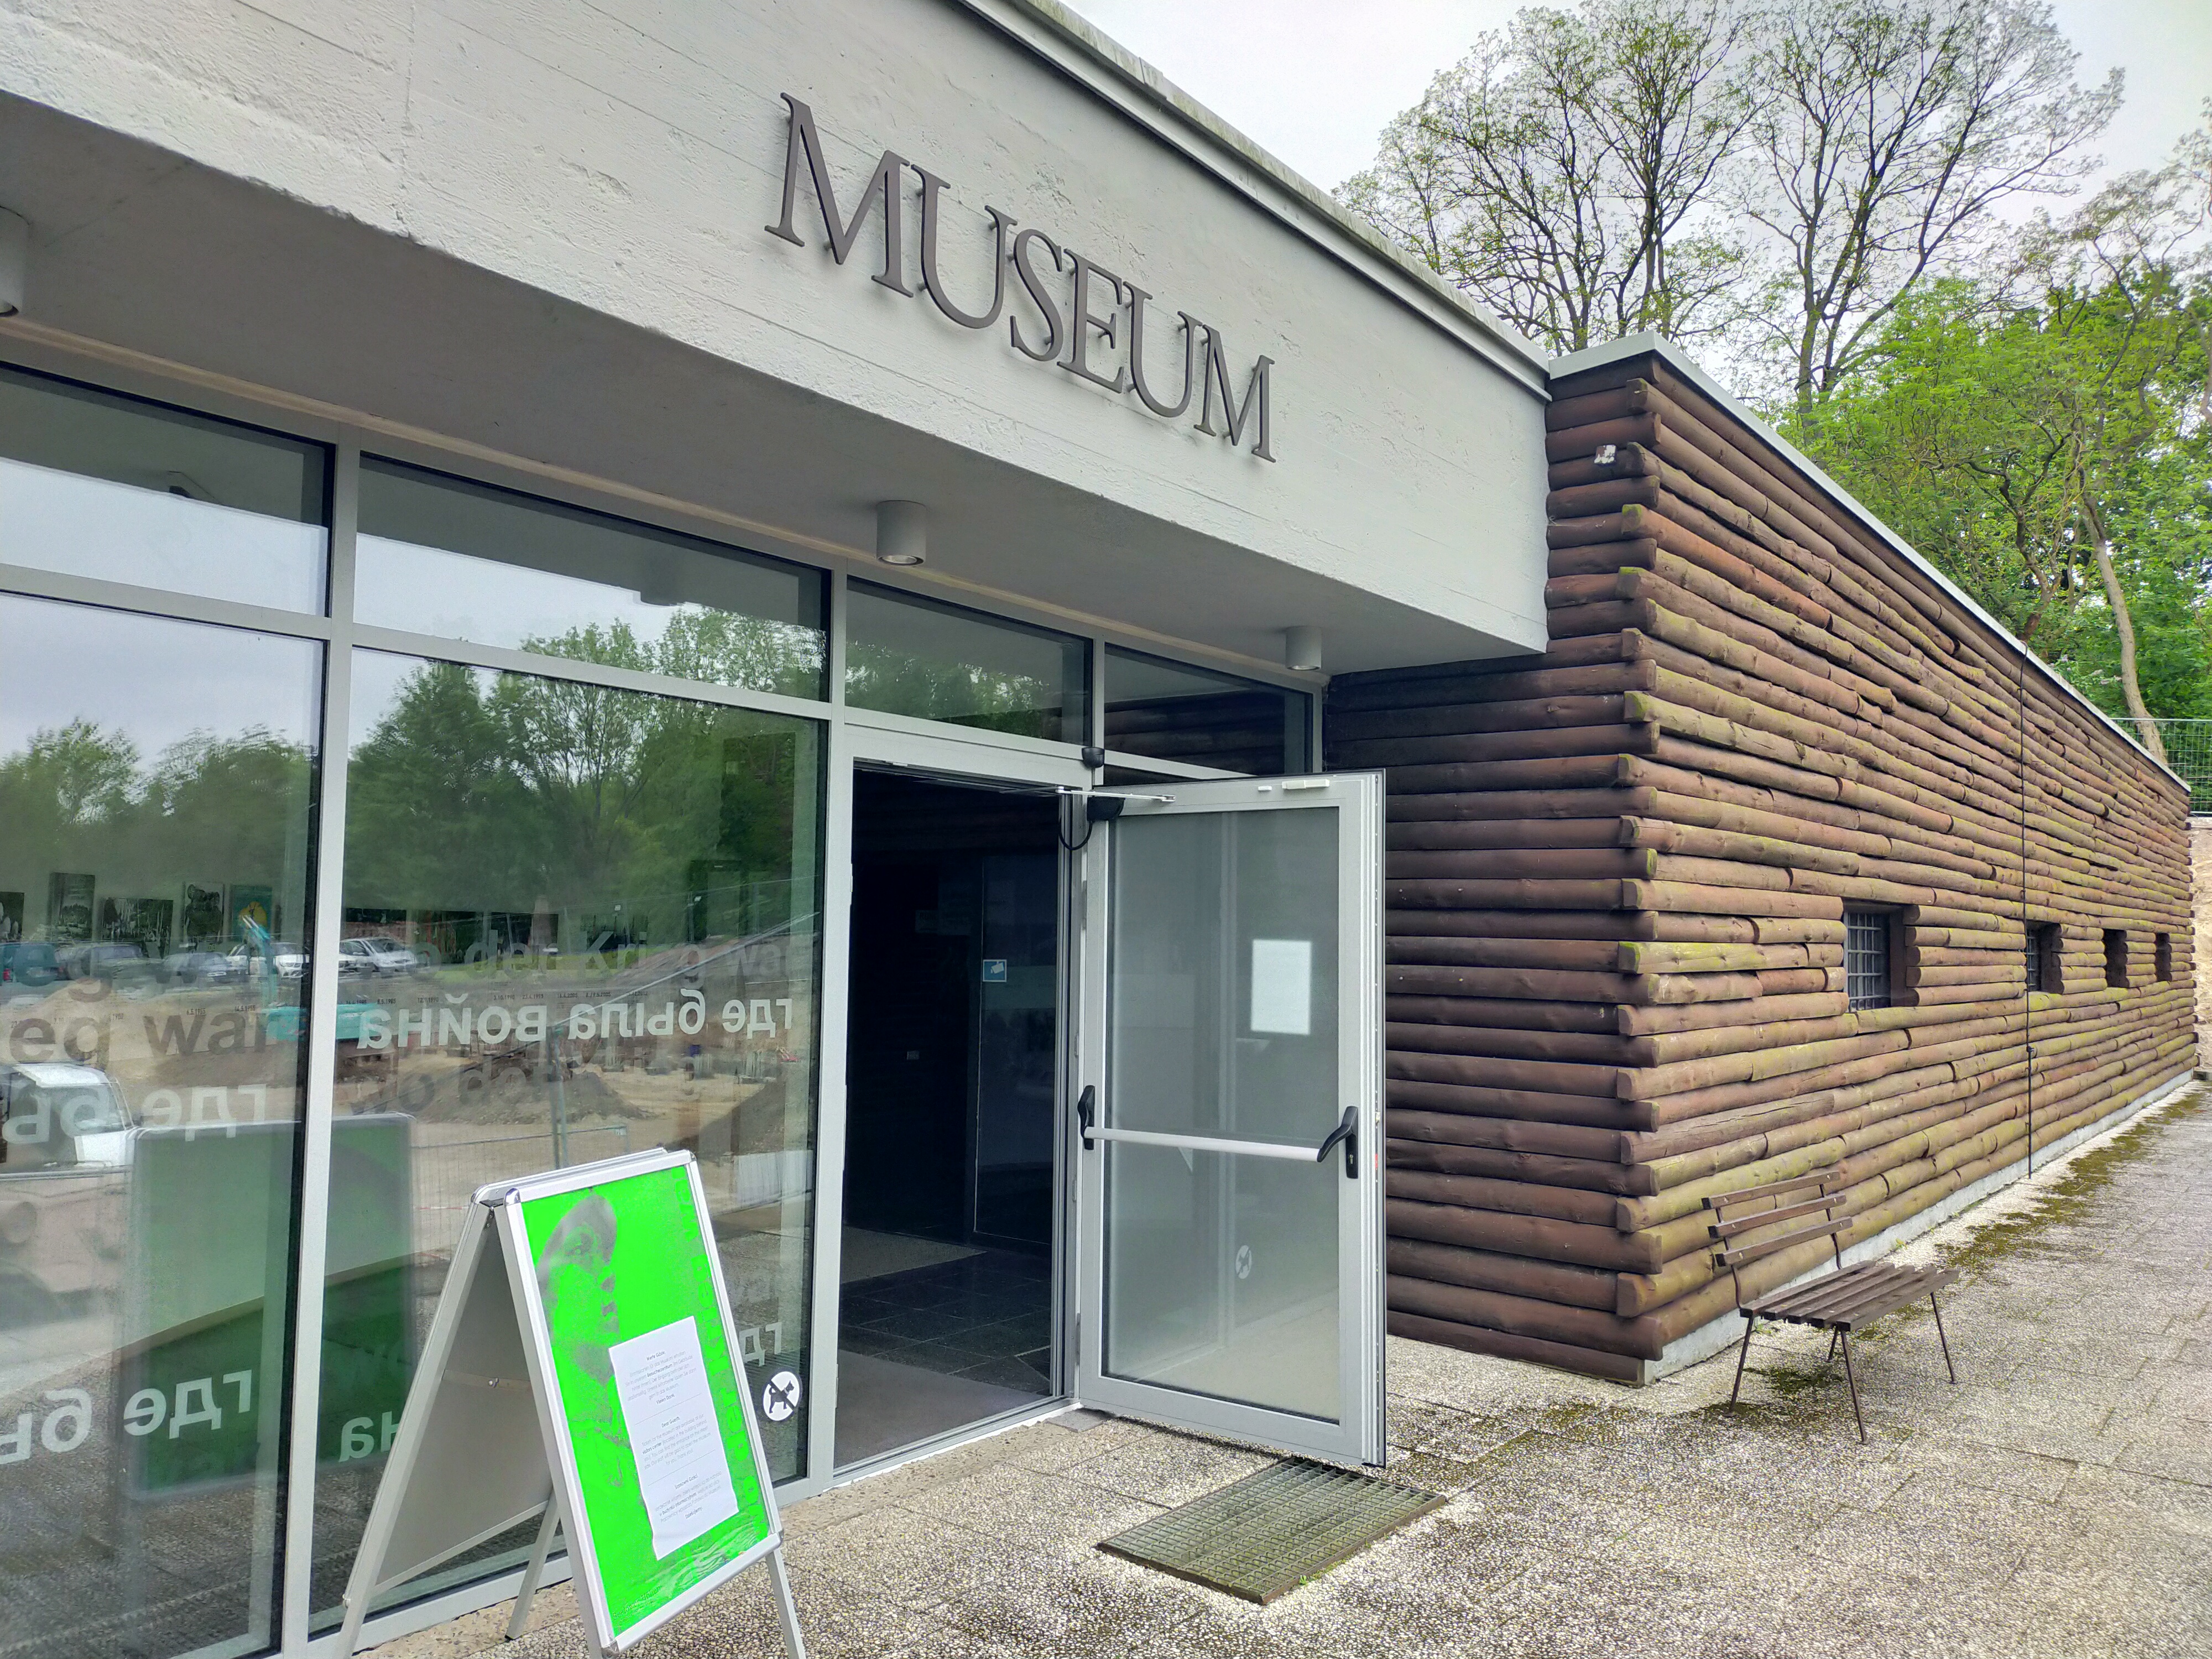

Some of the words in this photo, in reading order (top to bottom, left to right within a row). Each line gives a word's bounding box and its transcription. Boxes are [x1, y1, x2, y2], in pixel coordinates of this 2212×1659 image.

[765, 92, 1275, 462] MUSEUM
[691, 1254, 730, 1376] Krieg
[720, 1387, 749, 1461] der
